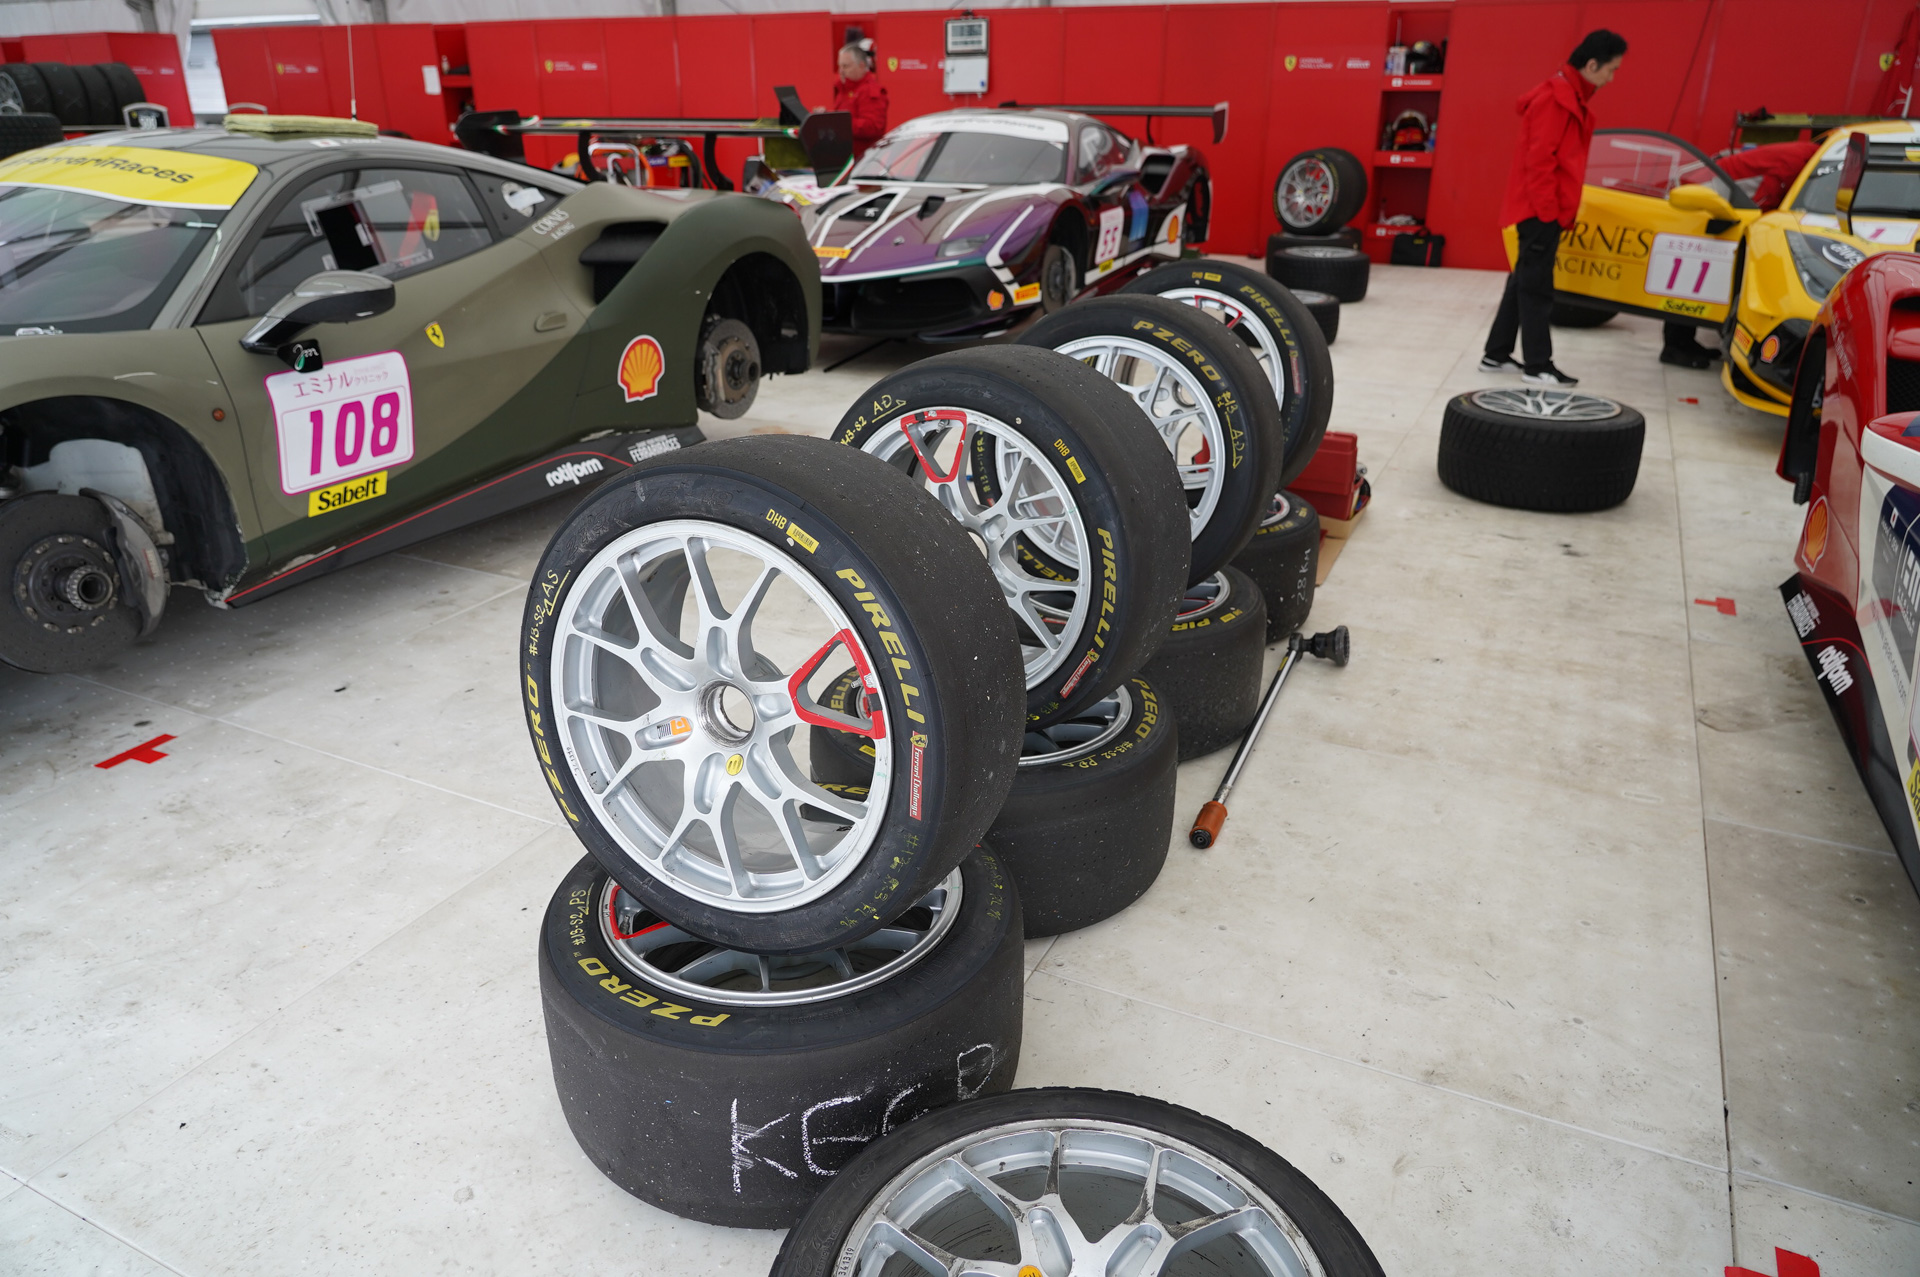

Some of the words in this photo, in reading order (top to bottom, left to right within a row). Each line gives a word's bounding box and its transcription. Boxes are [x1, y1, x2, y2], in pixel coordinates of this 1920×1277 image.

[1666, 258, 1711, 294] 11
[1240, 285, 1296, 347] PIRELLI
[1133, 320, 1222, 382] PZERO
[310, 391, 400, 476] 108
[1054, 438, 1071, 457] DHB
[318, 477, 380, 511] Sabelt
[545, 457, 605, 487] rotiform
[765, 508, 788, 530] DHB
[1097, 527, 1117, 649] PIRELLI
[836, 568, 925, 724] PIRELLI
[1816, 645, 1853, 695] rotiform
[1131, 678, 1159, 739] PZERO
[526, 674, 579, 823] PZERO
[913, 748, 923, 777] Ferrari
[910, 778, 921, 816] Challenge
[577, 956, 732, 1027] PZERO
